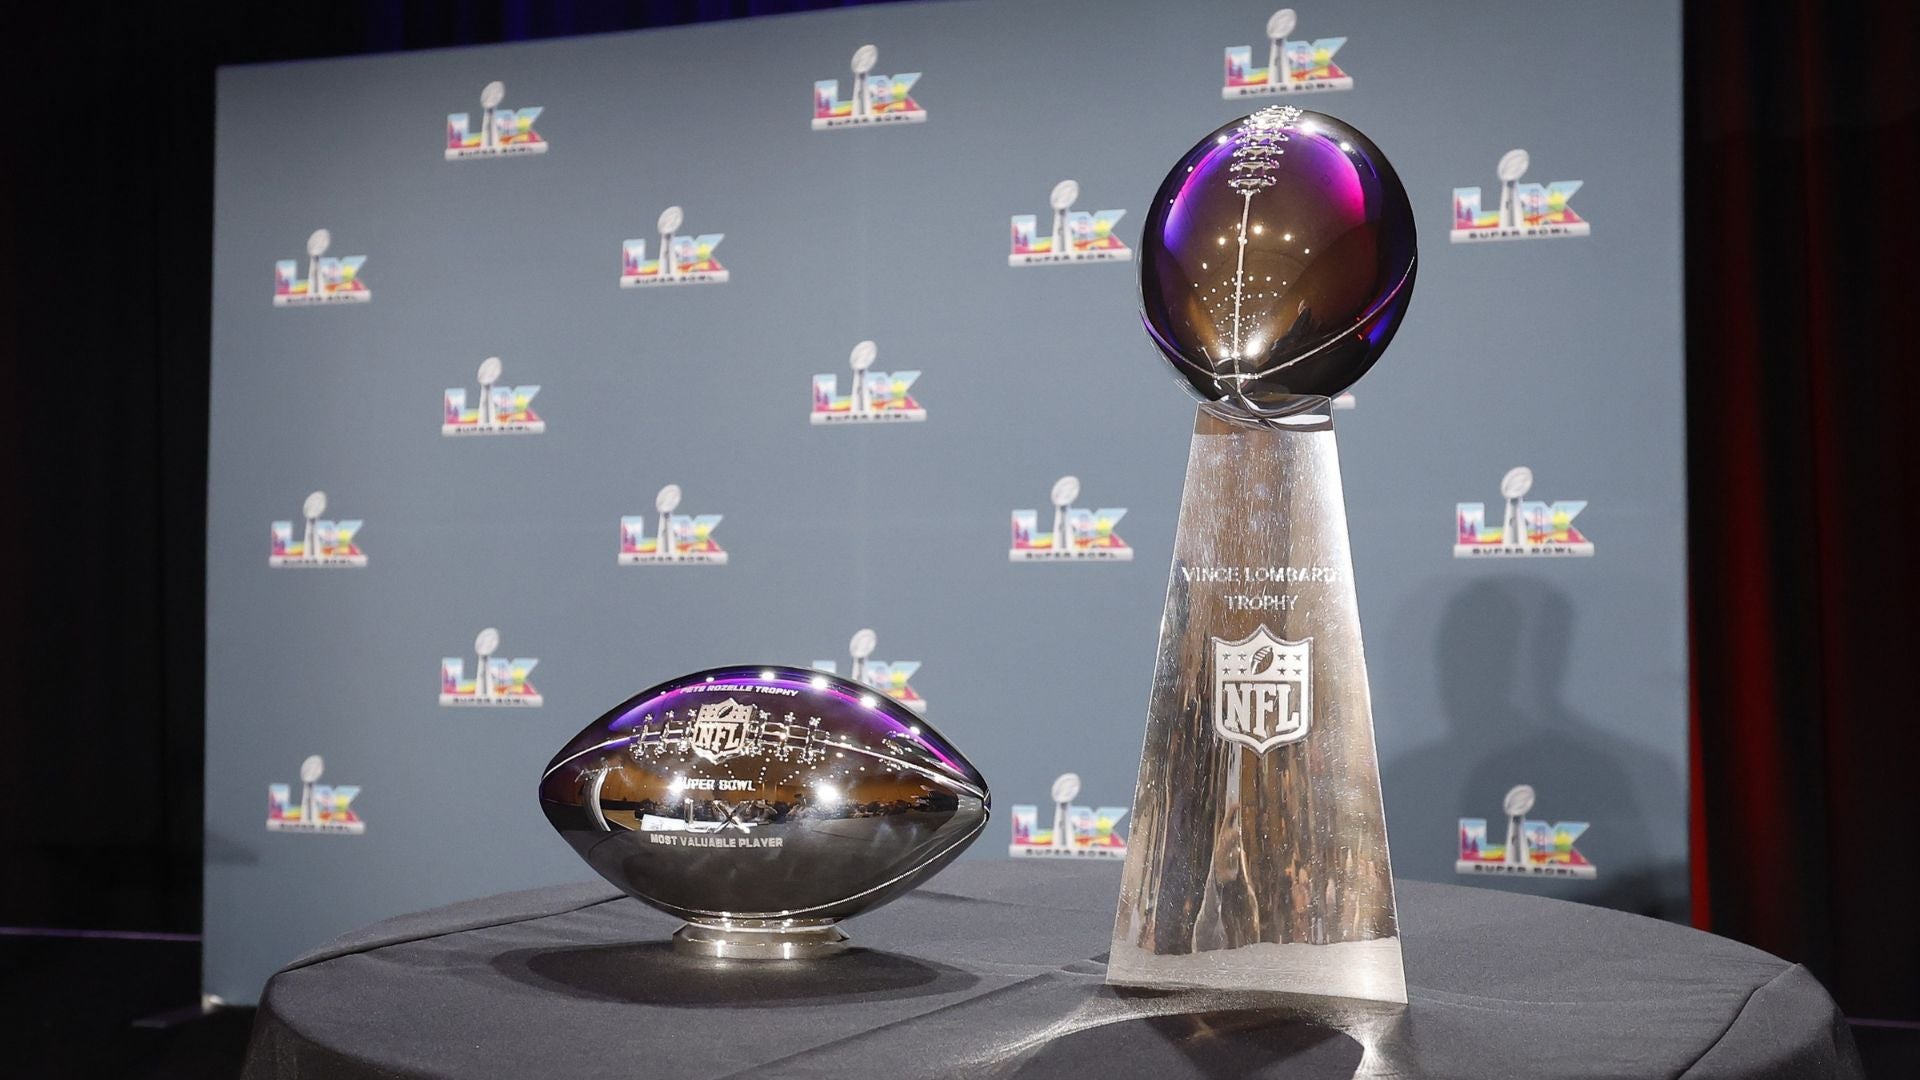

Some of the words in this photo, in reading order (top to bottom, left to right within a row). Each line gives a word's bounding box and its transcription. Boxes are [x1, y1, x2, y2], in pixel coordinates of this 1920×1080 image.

[1182, 566, 1239, 582] VINCE
[1245, 566, 1343, 582] LOMBARD
[1224, 594, 1299, 611] TROPHY
[706, 684, 753, 692] ROZELLE
[755, 686, 799, 697] TROPHY
[1222, 683, 1300, 738] NFL
[695, 722, 740, 755] NFL
[718, 778, 756, 792] BOWL
[650, 833, 678, 846] MOST
[680, 835, 736, 848] VALUABLE
[738, 837, 784, 848] PLAYER
